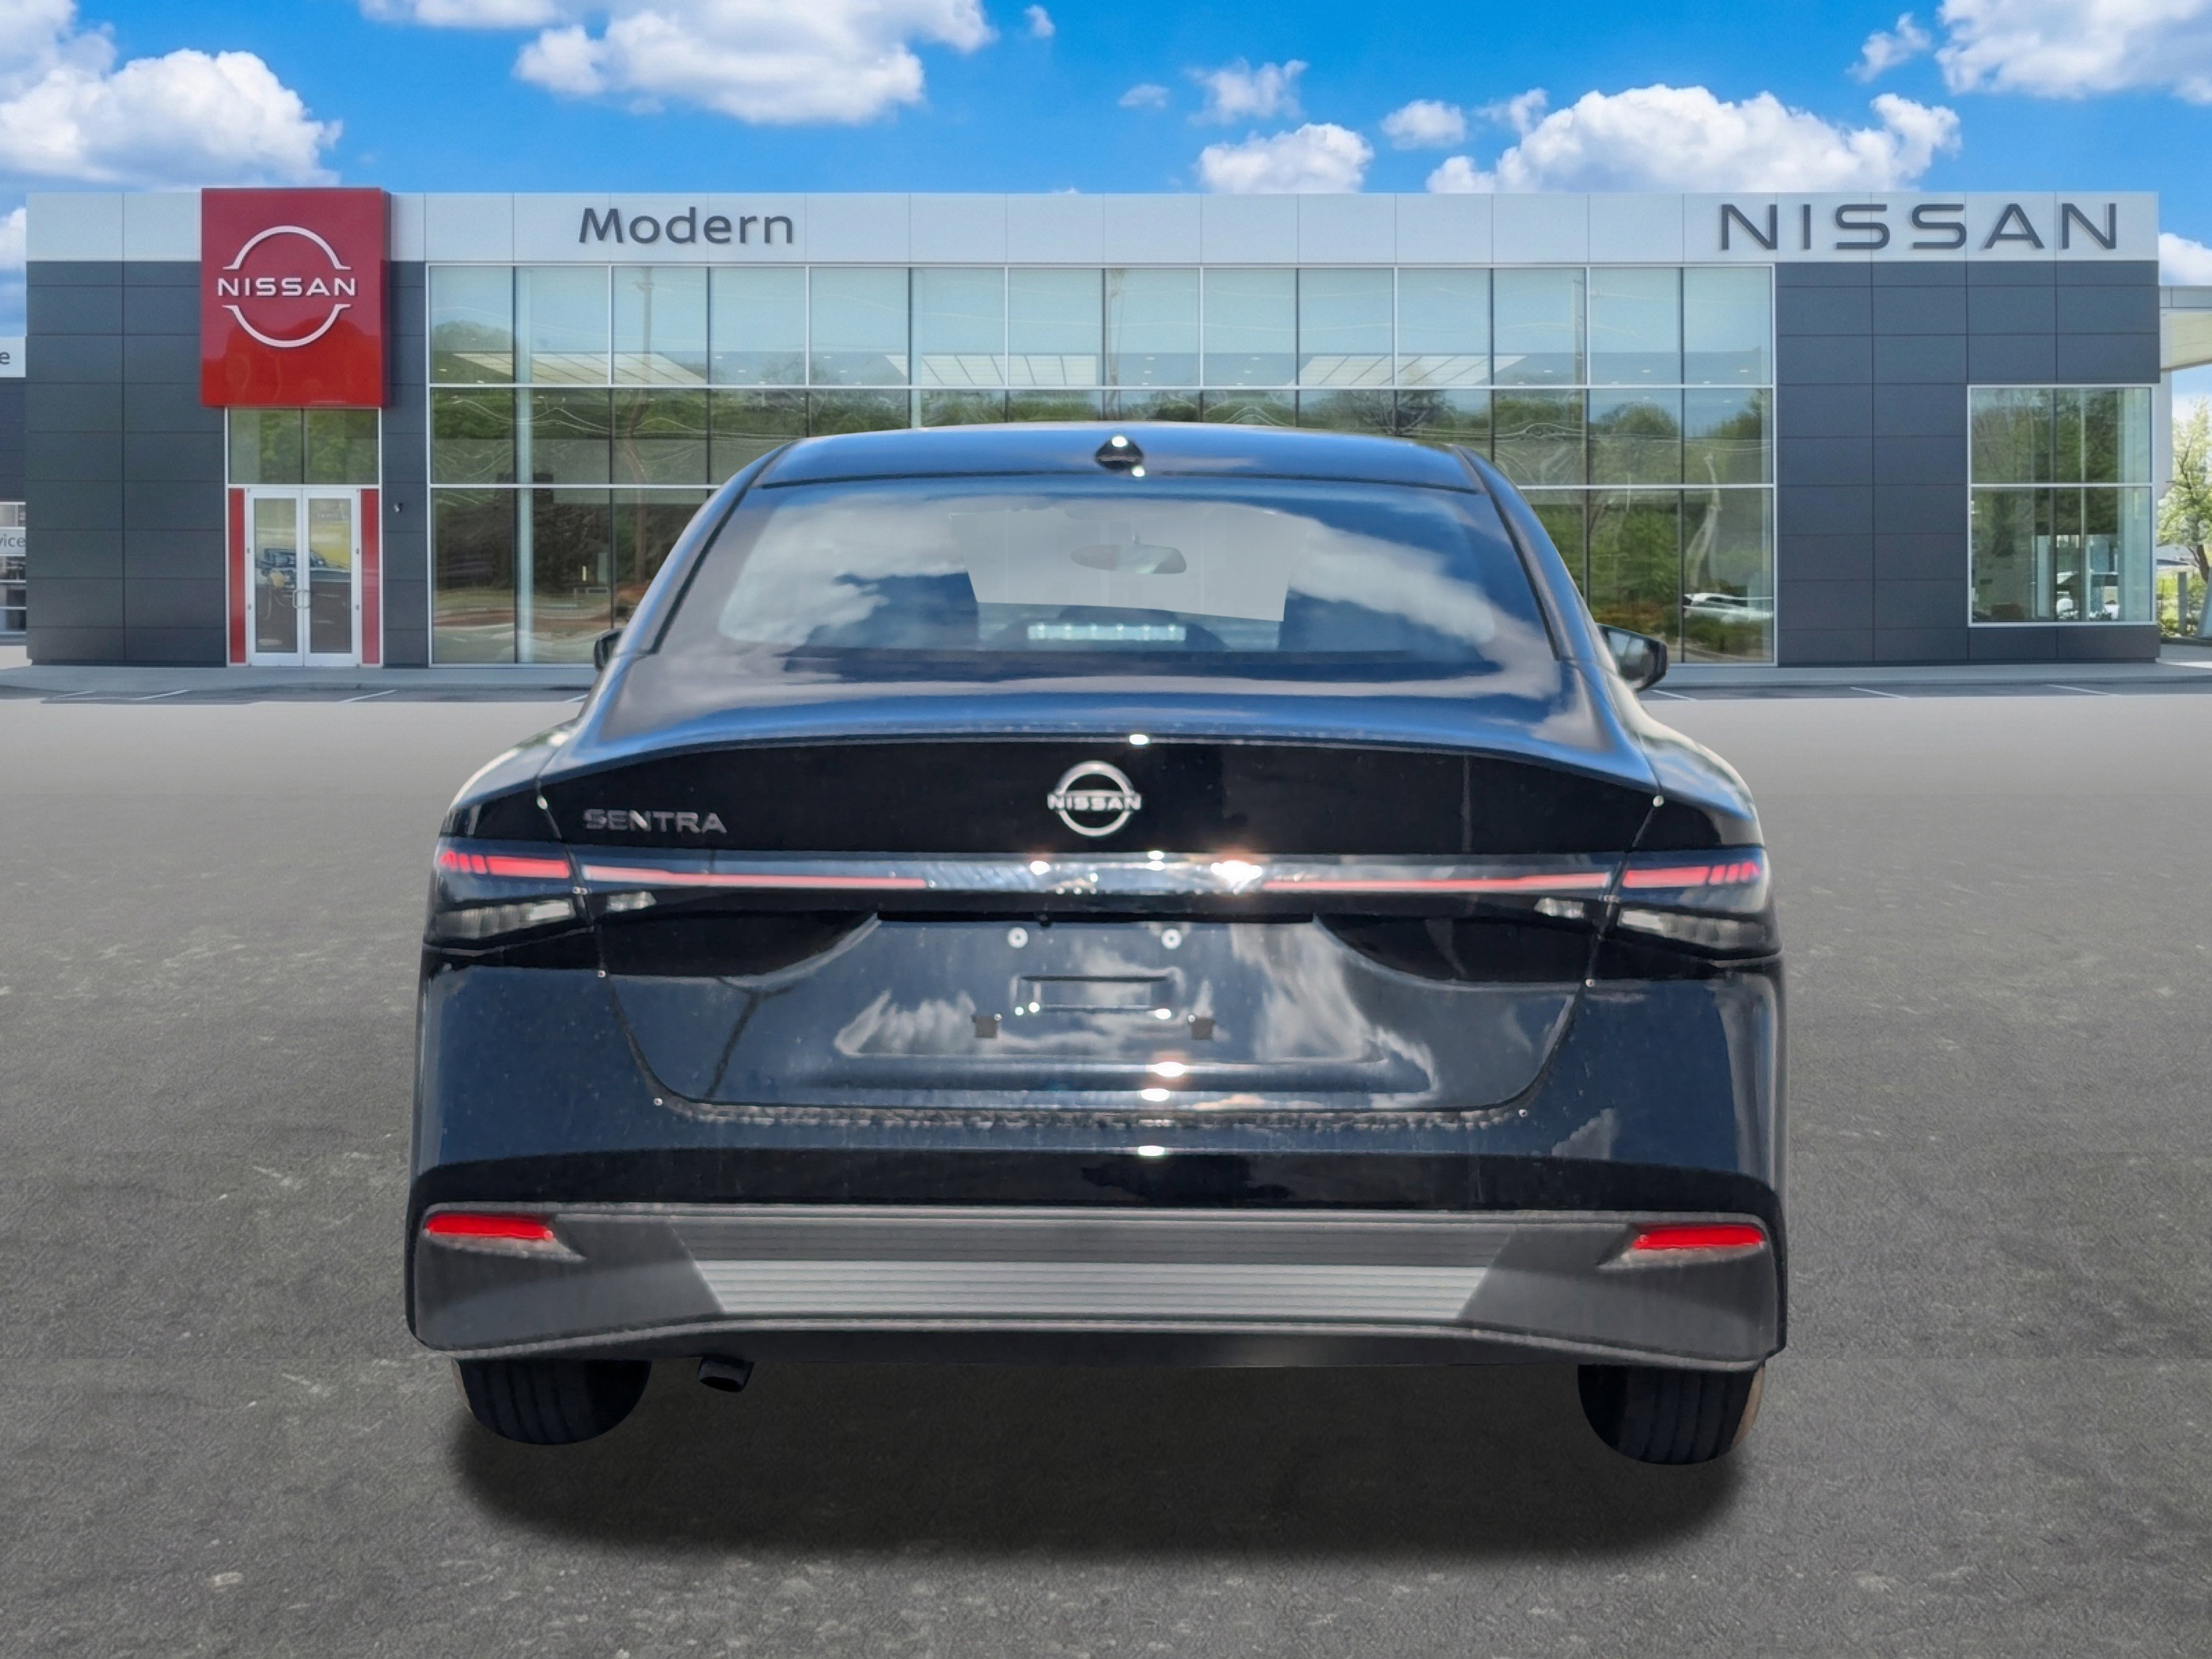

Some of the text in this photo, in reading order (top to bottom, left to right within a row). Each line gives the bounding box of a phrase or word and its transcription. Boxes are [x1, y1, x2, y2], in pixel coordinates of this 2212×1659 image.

[579, 207, 793, 244] Modern
[1720, 203, 2117, 250] NISSAN
[218, 278, 355, 296] NISSAN
[1047, 793, 1142, 811] NISSAN
[584, 809, 727, 833] SENTRA
